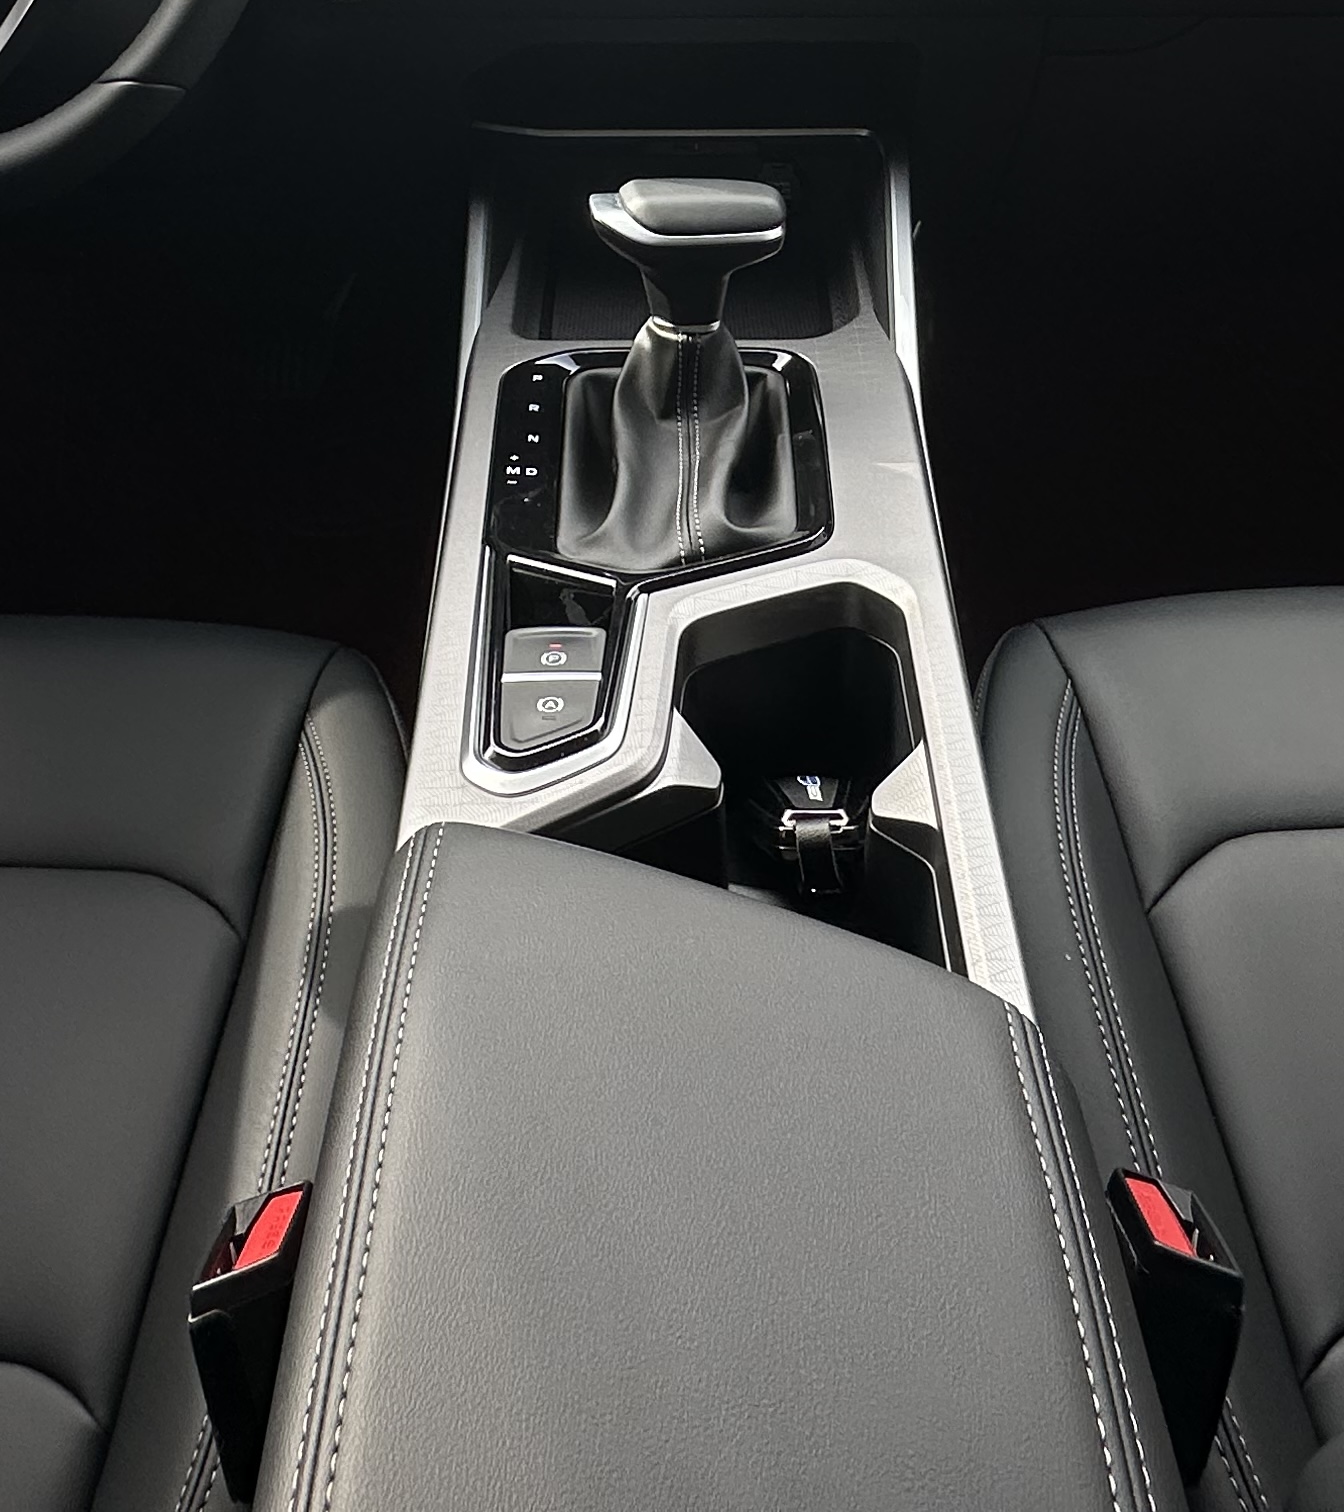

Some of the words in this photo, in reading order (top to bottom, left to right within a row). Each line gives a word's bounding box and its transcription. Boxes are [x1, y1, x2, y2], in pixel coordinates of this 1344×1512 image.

[532, 374, 543, 382] P
[528, 403, 540, 412] R
[527, 434, 540, 443] N
[506, 466, 521, 475] M
[525, 467, 538, 476] D
